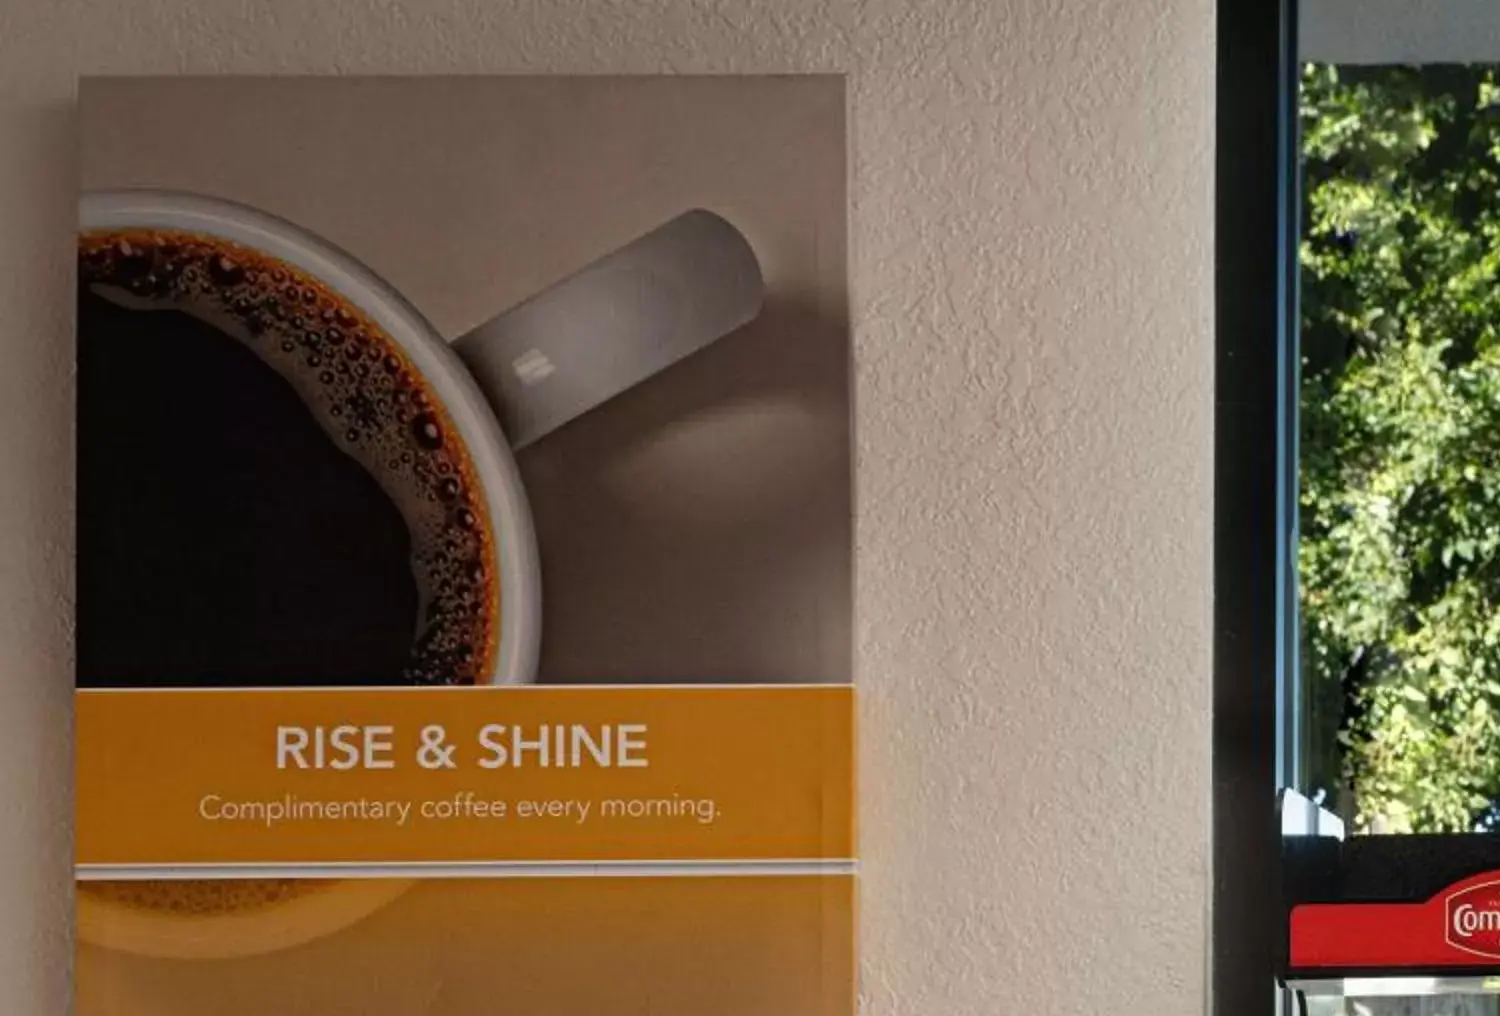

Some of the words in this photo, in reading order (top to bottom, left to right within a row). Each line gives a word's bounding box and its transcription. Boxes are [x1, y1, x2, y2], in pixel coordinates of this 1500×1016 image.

[276, 724, 395, 770] RISE
[416, 724, 457, 769] &
[477, 723, 649, 769] SHINE
[199, 794, 411, 827] Complimentary
[420, 791, 506, 818] coffee
[517, 798, 590, 825] every
[600, 793, 721, 824] morning.
